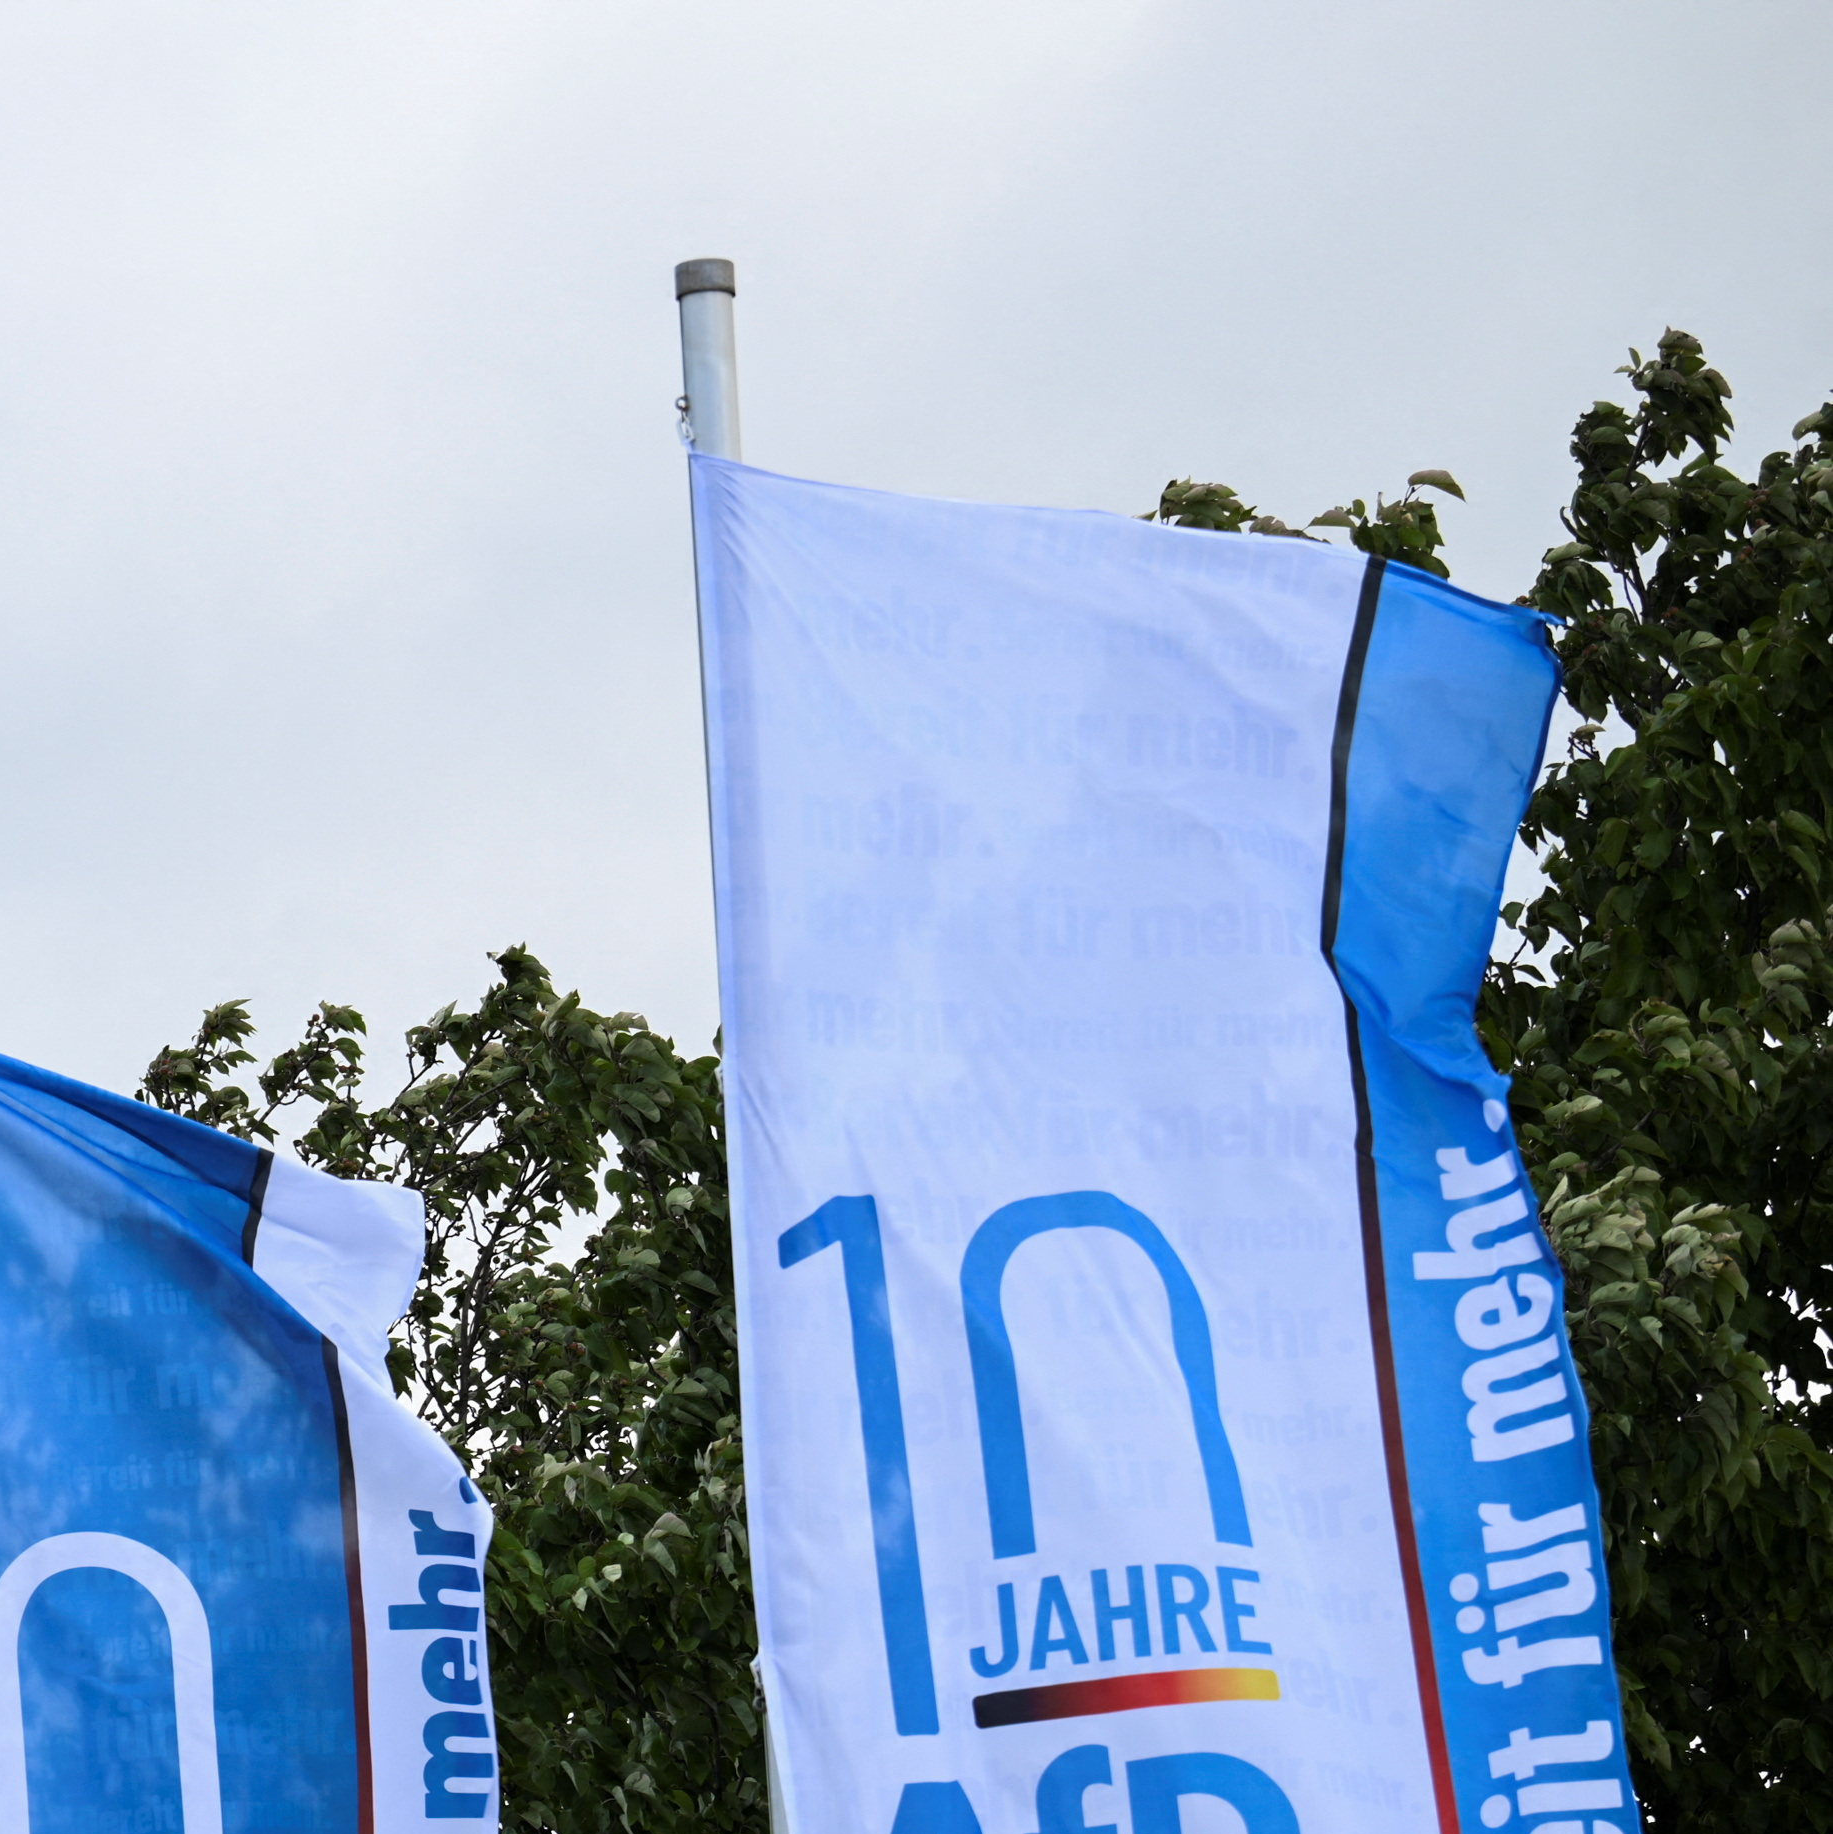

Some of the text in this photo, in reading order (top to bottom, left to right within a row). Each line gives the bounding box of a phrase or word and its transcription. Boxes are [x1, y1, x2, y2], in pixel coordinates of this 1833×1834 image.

[1413, 1095, 1574, 1459] mehr.
[388, 1476, 493, 1821] mehr.
[969, 1562, 1272, 1677] JAHRE
[1451, 1502, 1598, 1690] für
